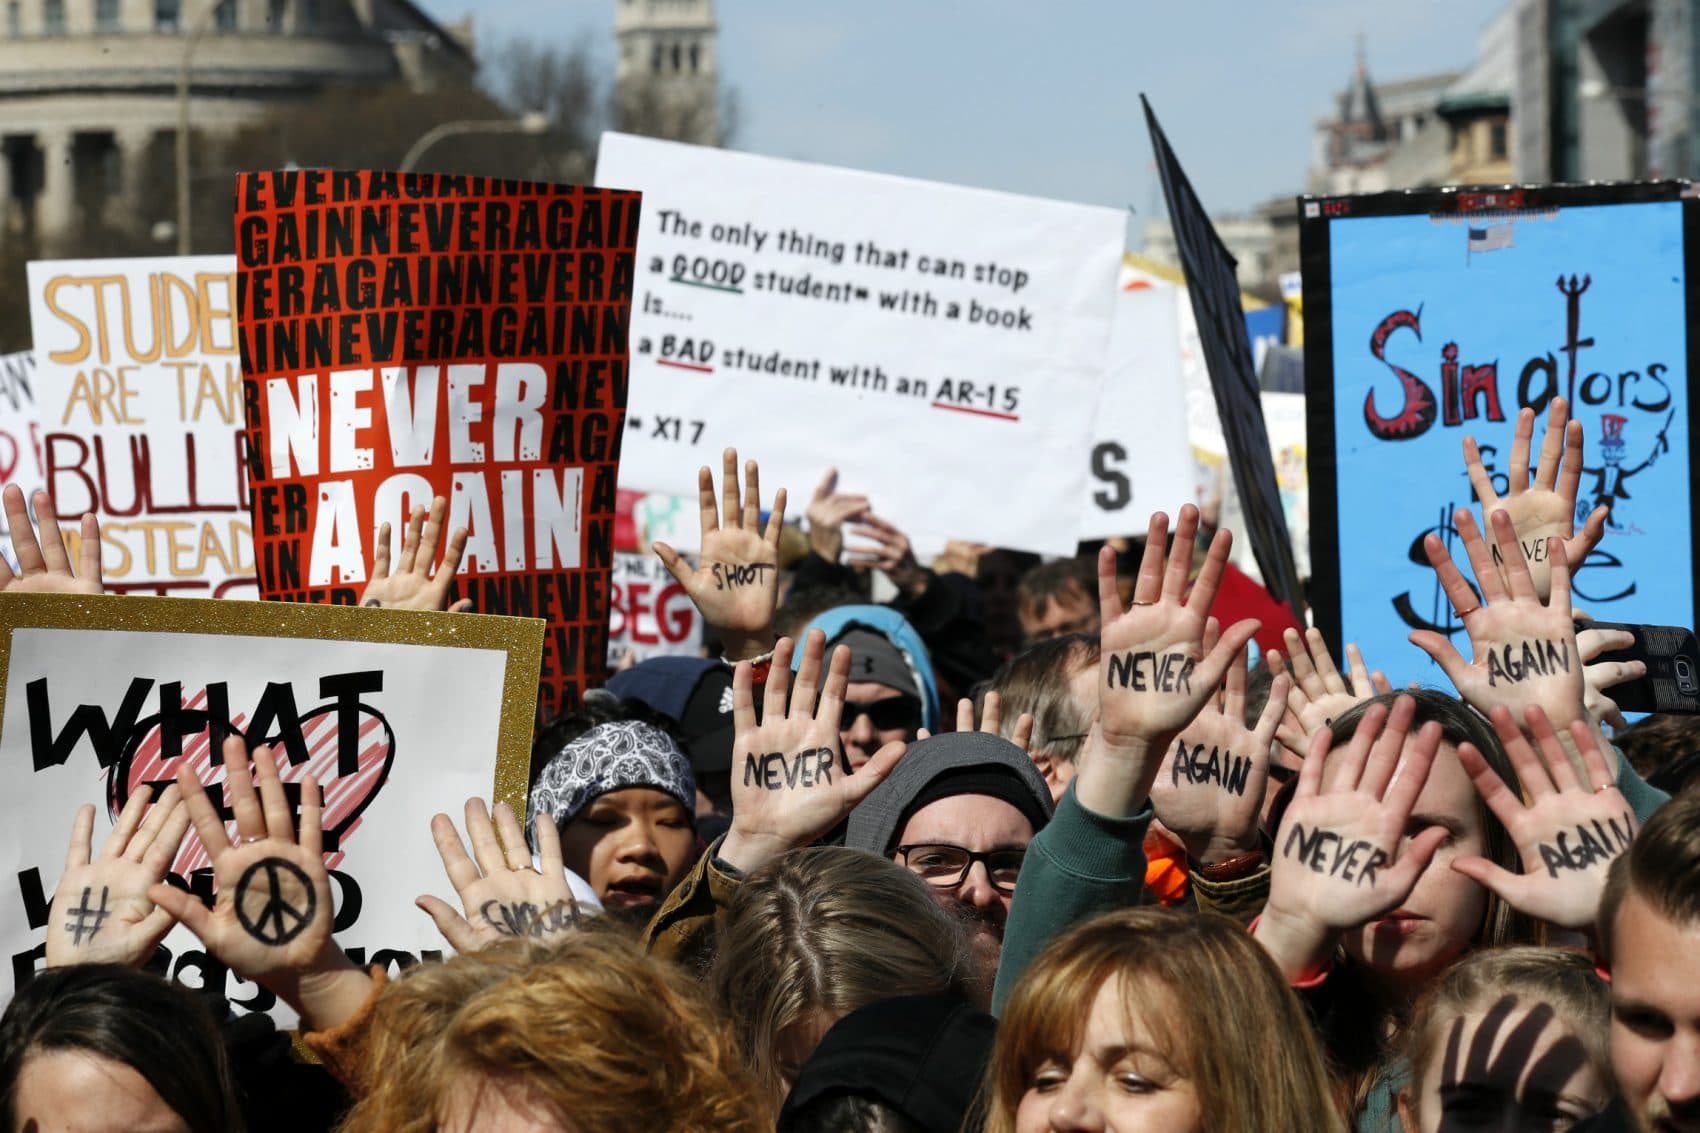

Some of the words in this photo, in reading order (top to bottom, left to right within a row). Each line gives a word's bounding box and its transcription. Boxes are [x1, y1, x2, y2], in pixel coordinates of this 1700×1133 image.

[656, 210, 703, 238] The
[710, 222, 767, 252] only
[778, 230, 844, 264] thing
[855, 242, 909, 271] that
[917, 255, 965, 280] can
[973, 263, 1029, 293] stop
[44, 272, 240, 364] STUDE
[649, 256, 664, 275] a
[672, 254, 746, 287] GOOD
[879, 290, 937, 317] with
[945, 300, 961, 319] a
[968, 299, 1032, 331] book
[62, 364, 145, 425] ARE
[638, 337, 653, 355] a
[660, 334, 715, 363] BAD
[722, 349, 820, 380] student
[829, 364, 888, 392] with
[896, 377, 928, 398] an
[935, 377, 1020, 411] AR-15
[267, 361, 548, 479] NEVER
[1461, 444, 1540, 503] fo
[309, 466, 584, 587] AGAIN
[711, 562, 776, 591] SHOOT
[1107, 651, 1199, 696] NEVER
[1488, 638, 1569, 687] AGAIN
[26, 670, 384, 779] WHAT
[743, 747, 834, 791] NEVER
[1171, 739, 1253, 797] AGAIN
[1283, 822, 1389, 890] NEVER
[1538, 811, 1637, 879] AGAIN
